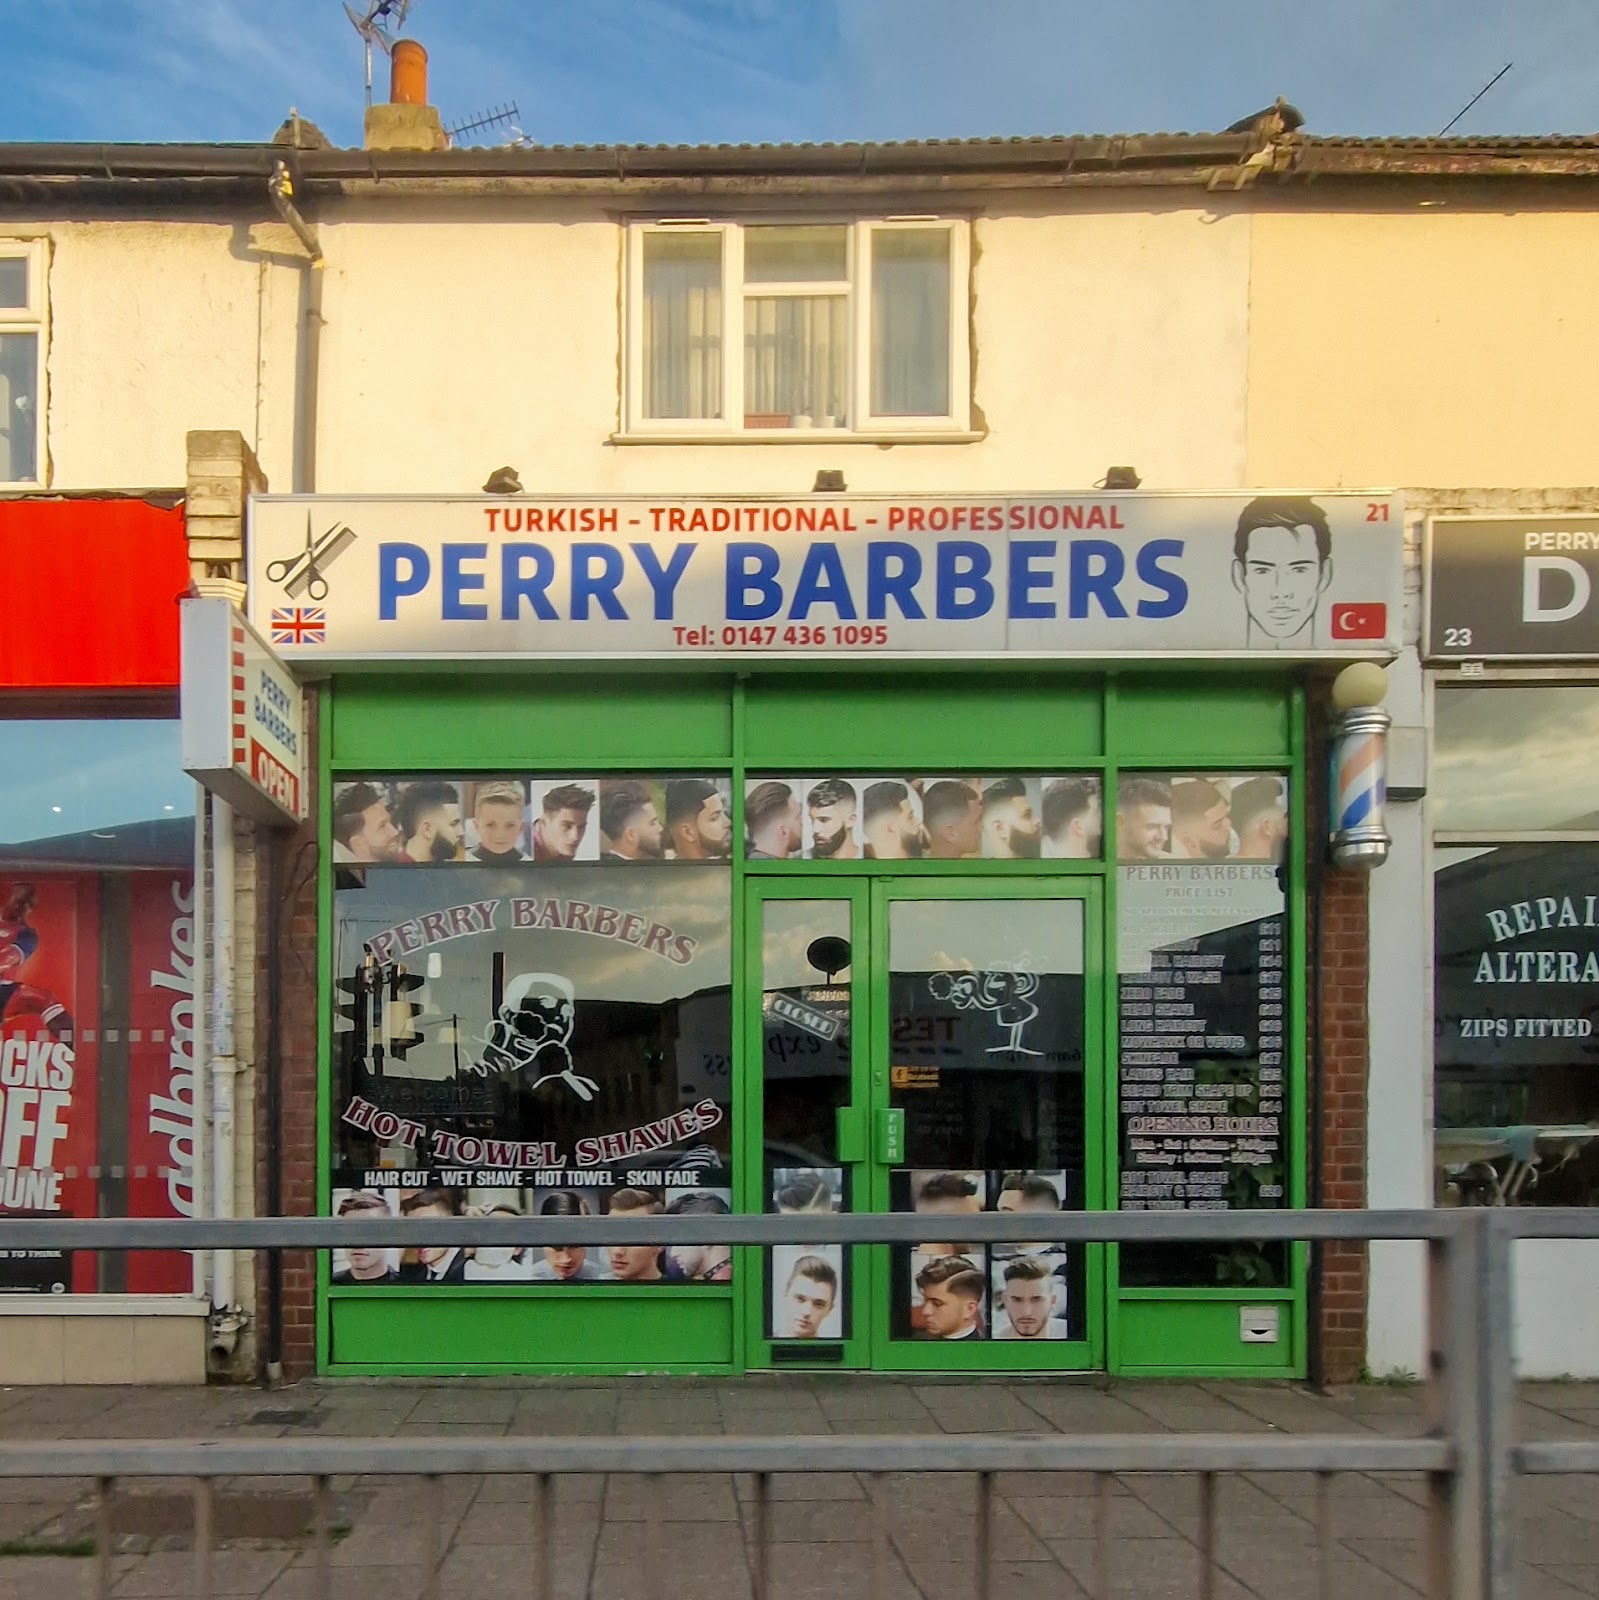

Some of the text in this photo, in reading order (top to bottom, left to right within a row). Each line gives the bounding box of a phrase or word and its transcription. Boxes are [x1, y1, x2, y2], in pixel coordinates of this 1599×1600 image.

[484, 508, 618, 532] TURKISH
[650, 507, 857, 532] TRADITIONAL
[889, 505, 1125, 531] PROFESSIONAL
[1366, 503, 1389, 522] 21
[378, 539, 1188, 621] PERRY BARBERS
[1523, 556, 1591, 622] D
[673, 626, 888, 646] Tel: 0147 436 1095
[1444, 628, 1472, 647] 23
[261, 669, 292, 717] PERRY
[254, 694, 297, 756] BARBERS
[257, 751, 294, 810] OPEN
[1126, 866, 1273, 881] PERRY BARBERS
[1165, 887, 1234, 898] PRICE LIST
[366, 897, 699, 967] PERRY BARBERS
[1486, 895, 1599, 942] REPAI
[774, 999, 833, 1034] CLOSED
[1460, 1018, 1592, 1038] ZIPS FITTED
[0, 1039, 76, 1091] CKS
[342, 1095, 723, 1168] HOT TOWEL SHAVES
[887, 1113, 898, 1158] PUSH
[1128, 1117, 1279, 1132] OPENING HOURS
[364, 1171, 399, 1186] HAIR
[401, 1171, 428, 1186] CUT
[441, 1171, 473, 1186] WET
[476, 1171, 523, 1186] SHAVE
[535, 1171, 561, 1186] HOT
[565, 1171, 615, 1186] TOWEL
[626, 1171, 662, 1186] SKIN
[665, 1171, 700, 1186] FADE
